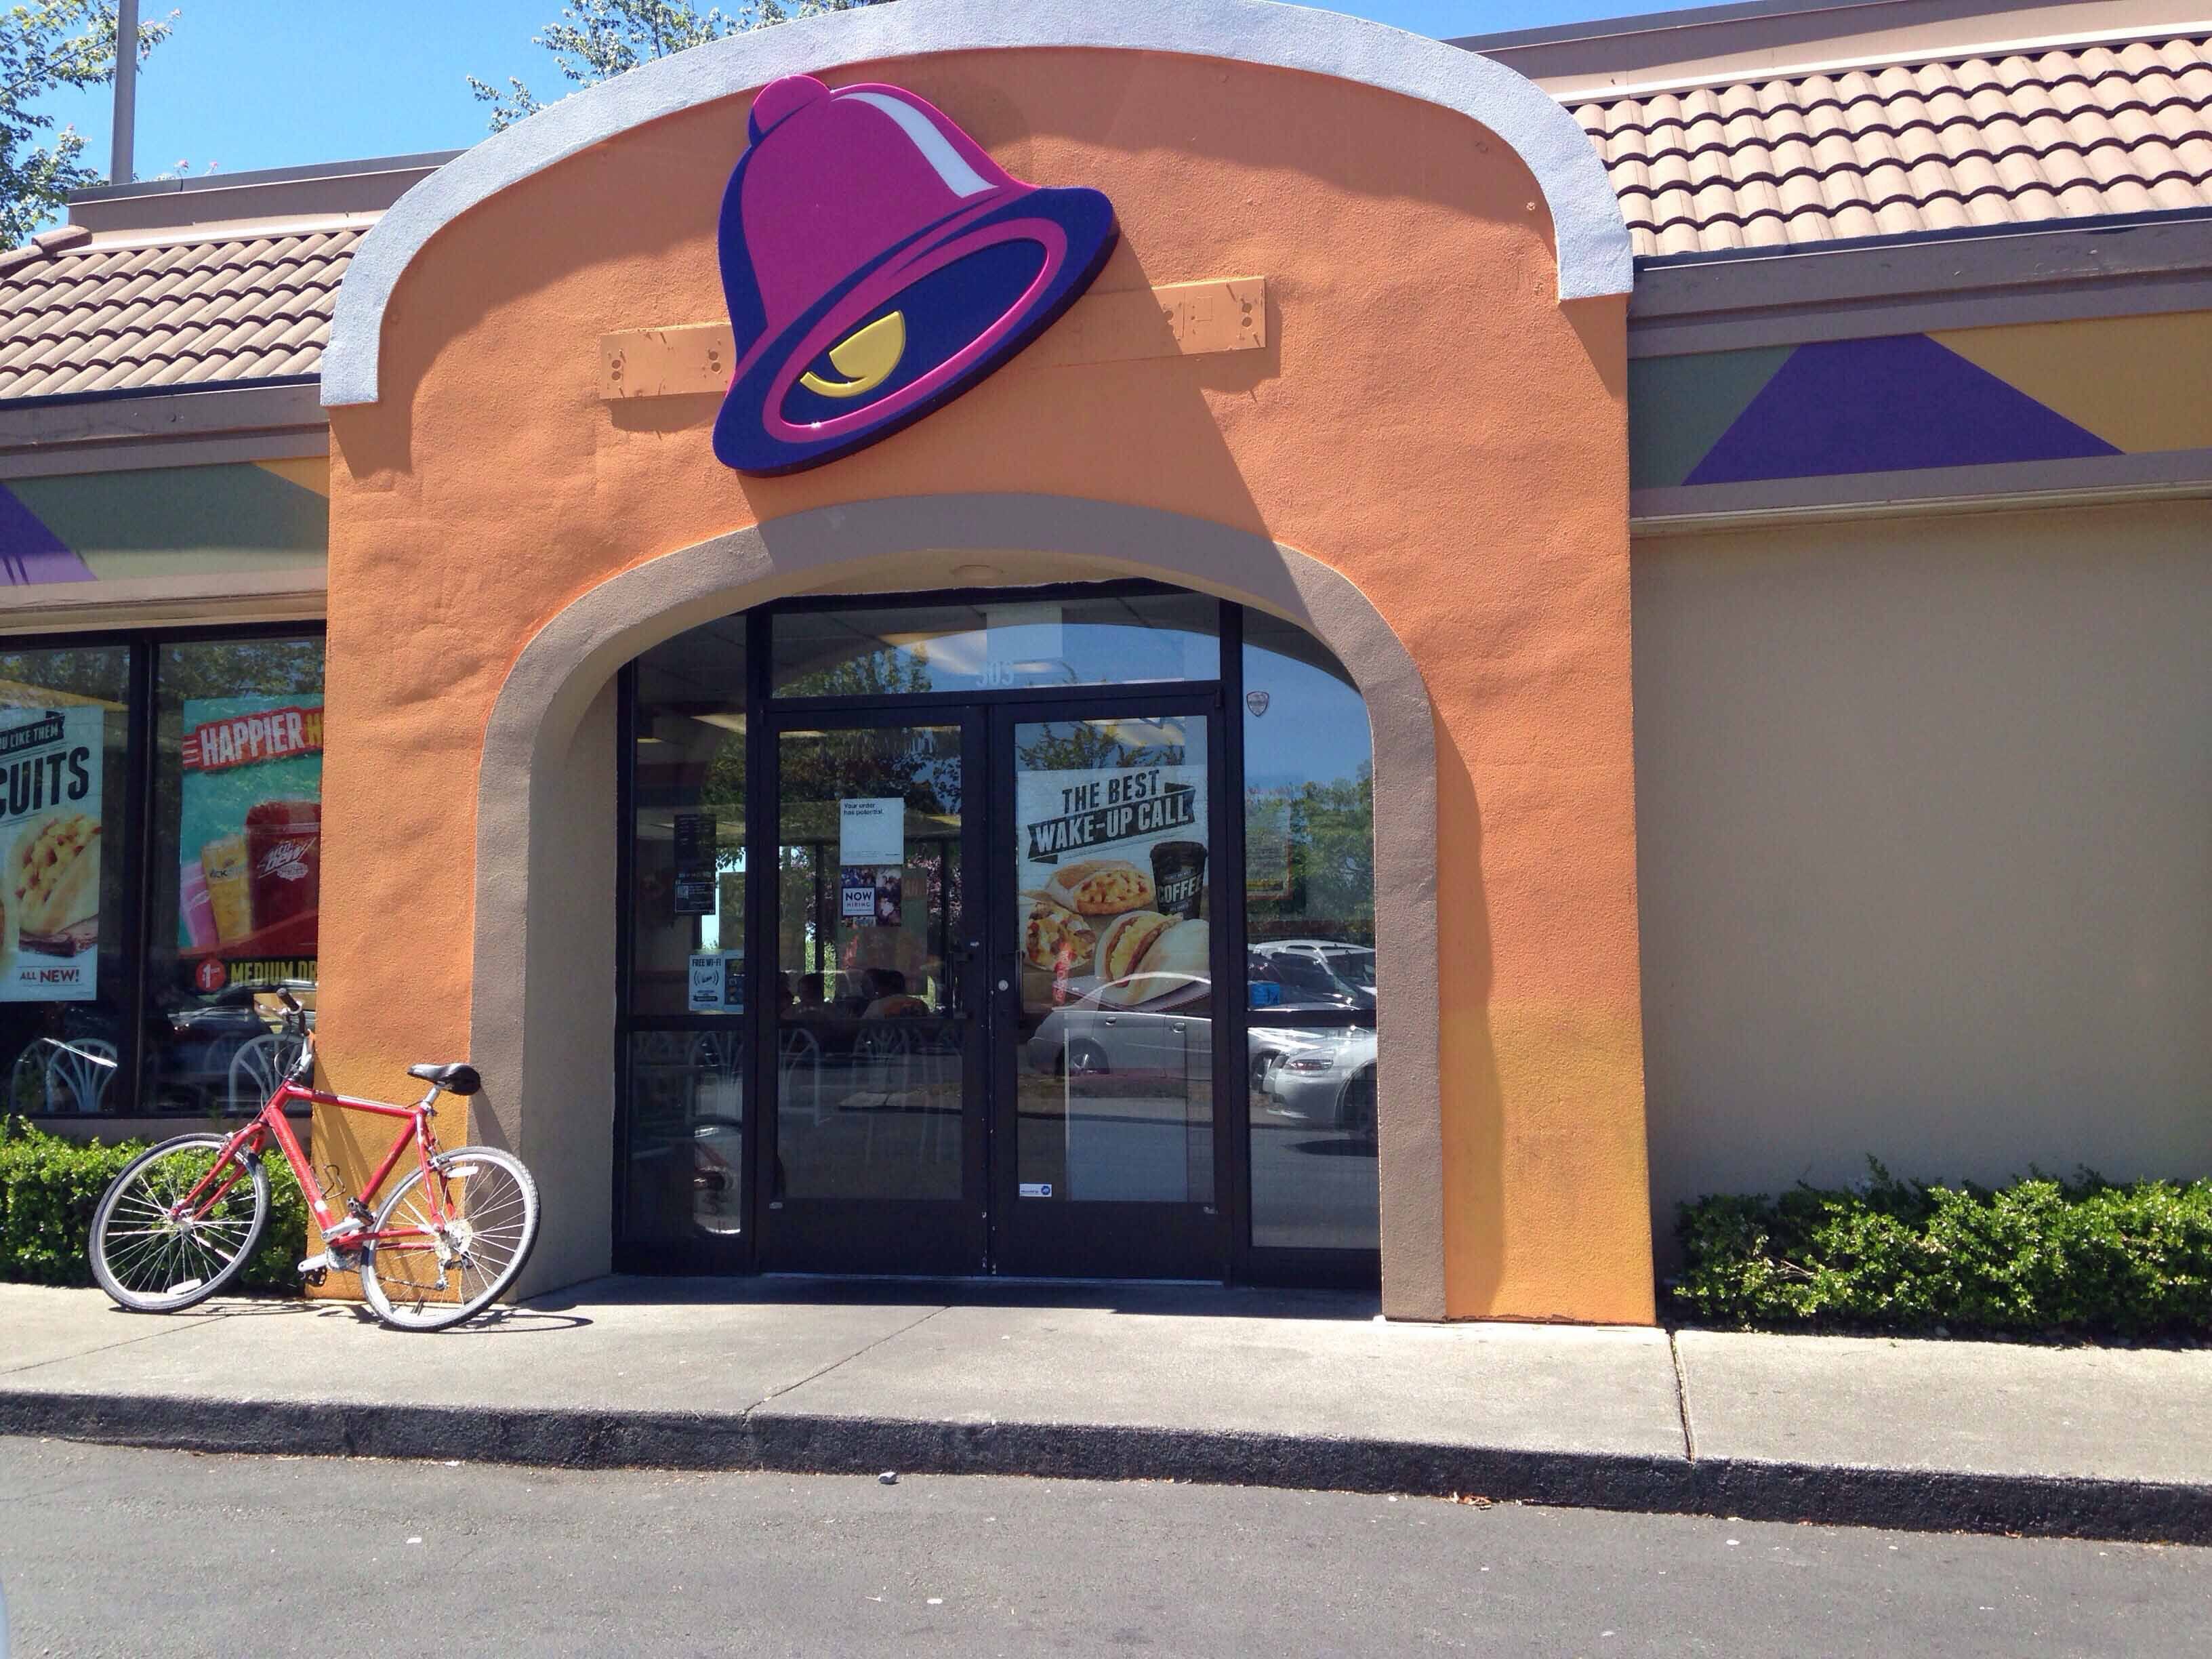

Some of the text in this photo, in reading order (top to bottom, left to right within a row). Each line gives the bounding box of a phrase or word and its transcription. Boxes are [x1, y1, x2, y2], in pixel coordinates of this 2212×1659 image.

[10, 730, 31, 747] LIKE
[33, 722, 59, 742] THEM
[201, 712, 305, 766] HAPPIER
[1062, 769, 1160, 813] THE BEST
[1035, 794, 1189, 853] WAKE-UP CALL
[846, 892, 872, 901] NOW
[230, 961, 293, 986] MEDIUM
[692, 958, 705, 967] FREE
[20, 969, 79, 983] ALL NEW!
